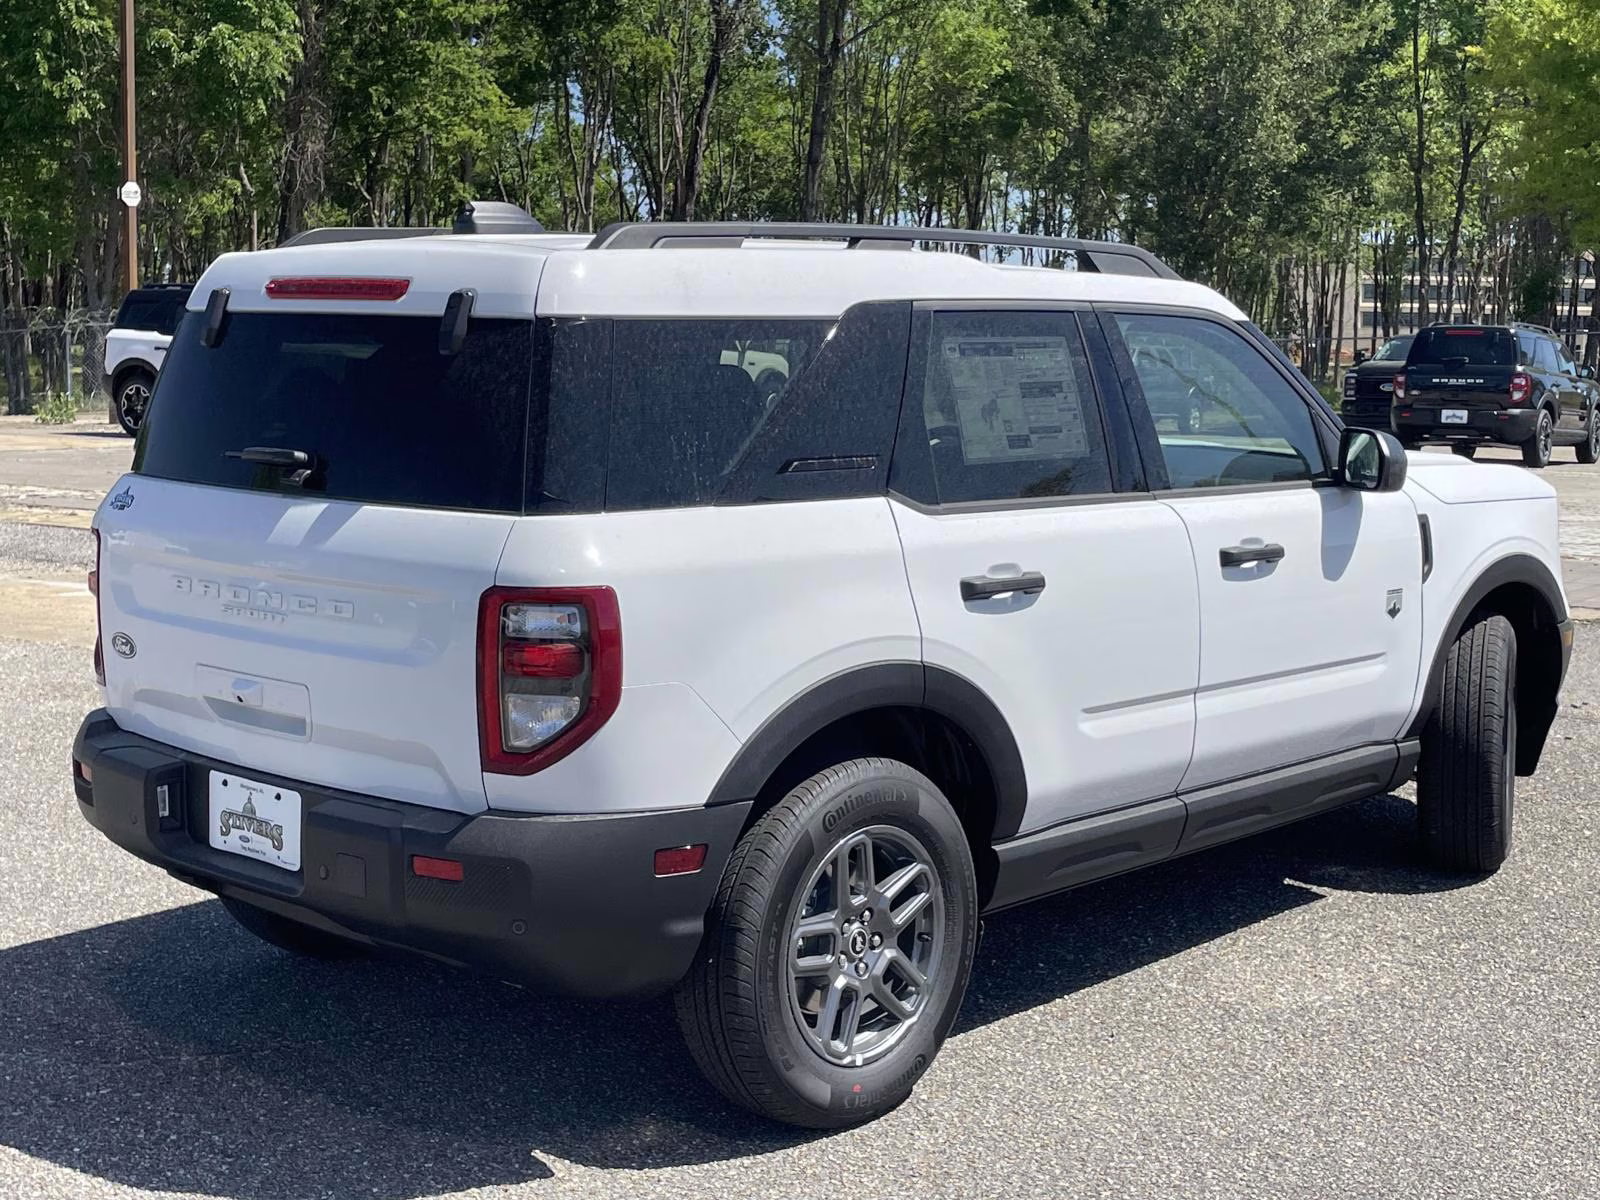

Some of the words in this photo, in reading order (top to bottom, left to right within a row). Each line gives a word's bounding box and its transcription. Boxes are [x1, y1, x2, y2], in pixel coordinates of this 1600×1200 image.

[172, 575, 355, 618] BRONCO
[220, 809, 284, 851] STIVERS
[822, 786, 898, 833] Continental
